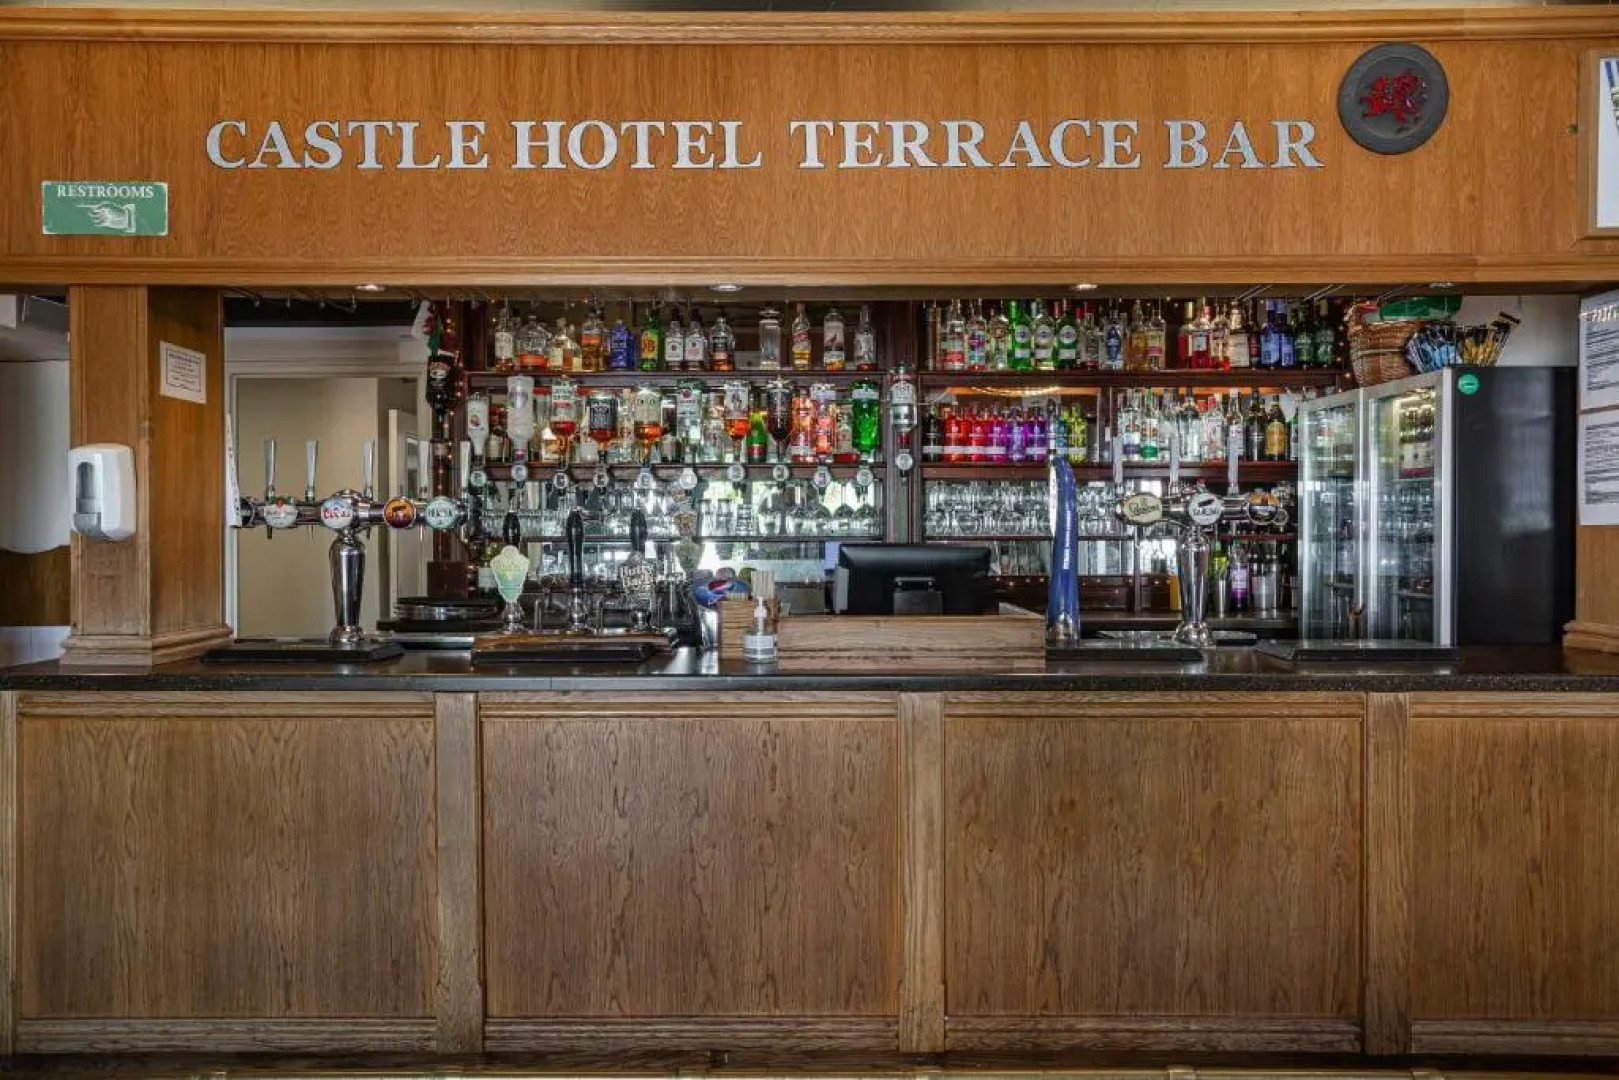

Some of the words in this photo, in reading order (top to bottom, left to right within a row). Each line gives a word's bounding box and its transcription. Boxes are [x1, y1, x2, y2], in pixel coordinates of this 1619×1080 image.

[206, 120, 489, 169] CASTLE
[511, 119, 763, 169] HOTEL
[789, 119, 1142, 169] TERRACE
[1163, 119, 1326, 169] BAR
[56, 184, 155, 199] RESTROOMS
